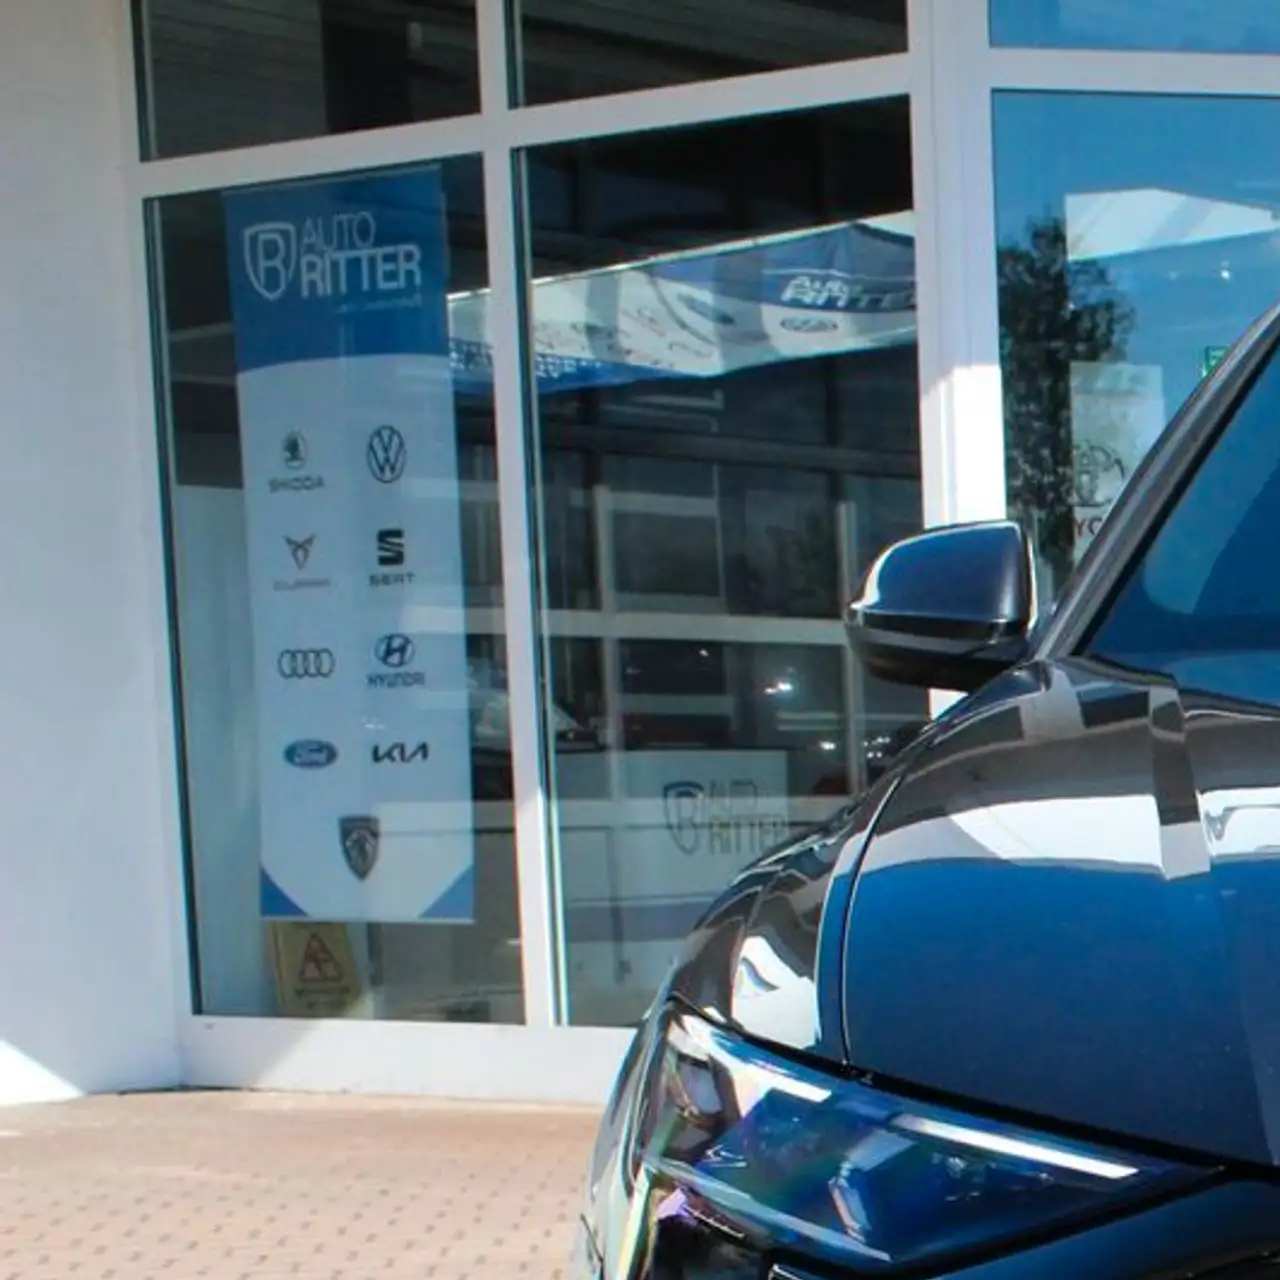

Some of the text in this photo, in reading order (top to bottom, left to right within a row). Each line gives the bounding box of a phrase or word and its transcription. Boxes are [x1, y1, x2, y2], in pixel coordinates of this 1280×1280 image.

[303, 211, 376, 250] AUTO
[301, 244, 422, 297] RITTER
[369, 571, 415, 588] SEAT
